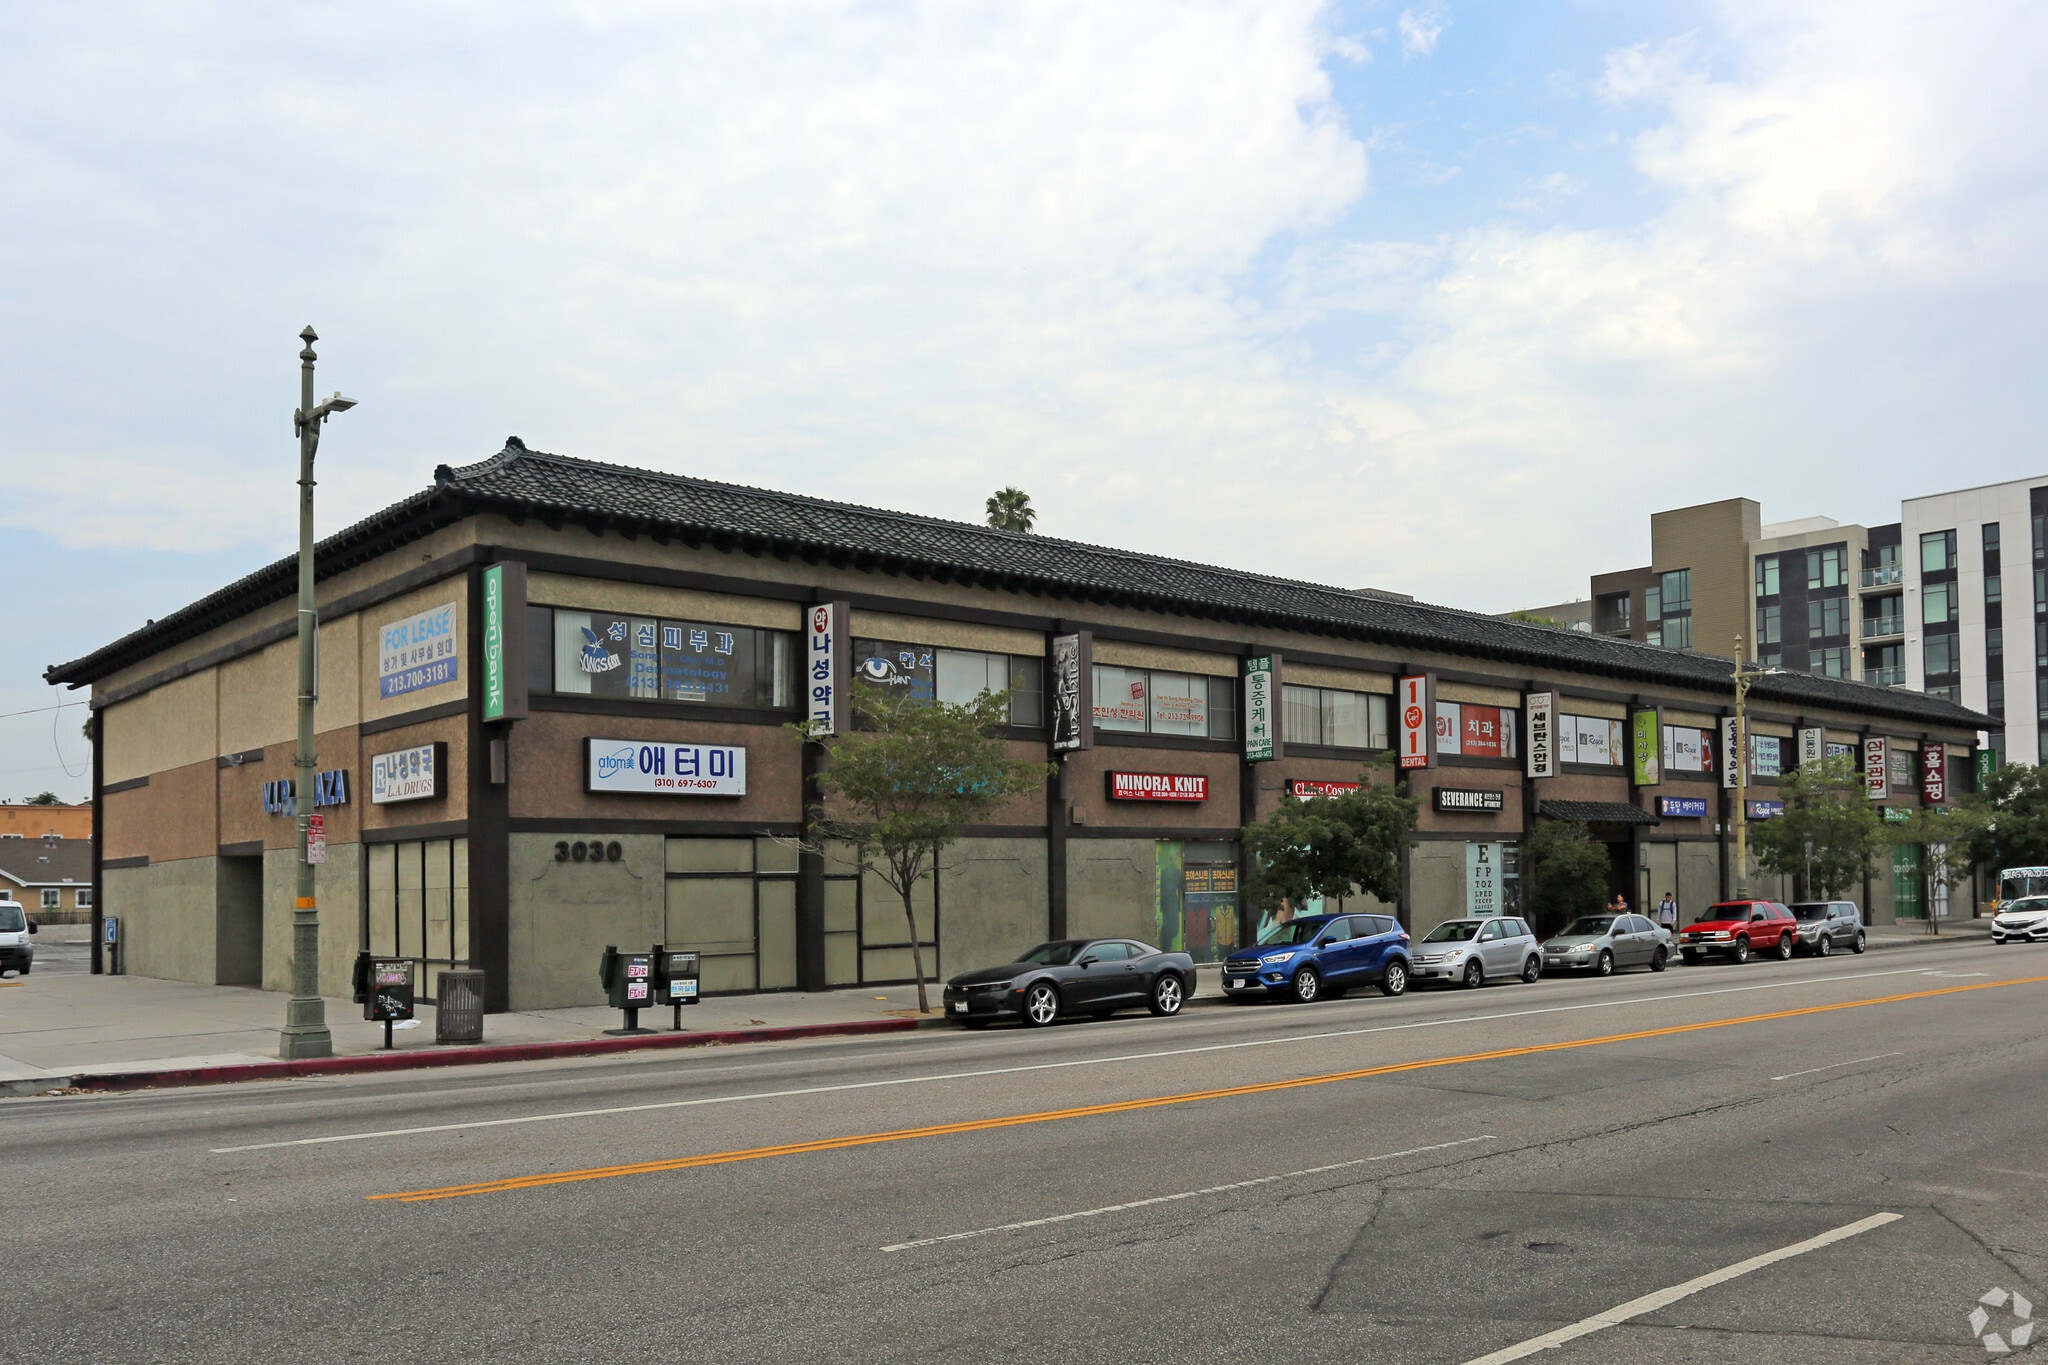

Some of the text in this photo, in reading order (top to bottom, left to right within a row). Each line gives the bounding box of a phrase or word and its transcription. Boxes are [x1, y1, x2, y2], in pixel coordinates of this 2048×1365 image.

[385, 612, 451, 652] FOR LEASE
[607, 621, 734, 655] 성심피부과
[486, 577, 501, 708] open bank
[383, 638, 453, 672] 상가 및 사무실 임대
[630, 650, 658, 662] Song
[388, 663, 449, 693] 213.700-3181
[635, 663, 727, 680] Dermatology
[1120, 708, 1145, 720] 한의원
[1468, 719, 1494, 737] 치과
[1247, 738, 1271, 748] PAIN CARE
[639, 746, 734, 778] 애터미
[1401, 758, 1426, 767] DENTAL
[654, 778, 718, 789] (310) 697-6307
[1116, 774, 1205, 792] MINORA KNIT
[1925, 752, 1943, 799] 홈쇼핑
[314, 768, 347, 807] AZA
[403, 778, 433, 796] DRUGS
[1441, 791, 1483, 807] SEVERANCE
[554, 841, 622, 863] 3030
[1477, 845, 1489, 864] E
